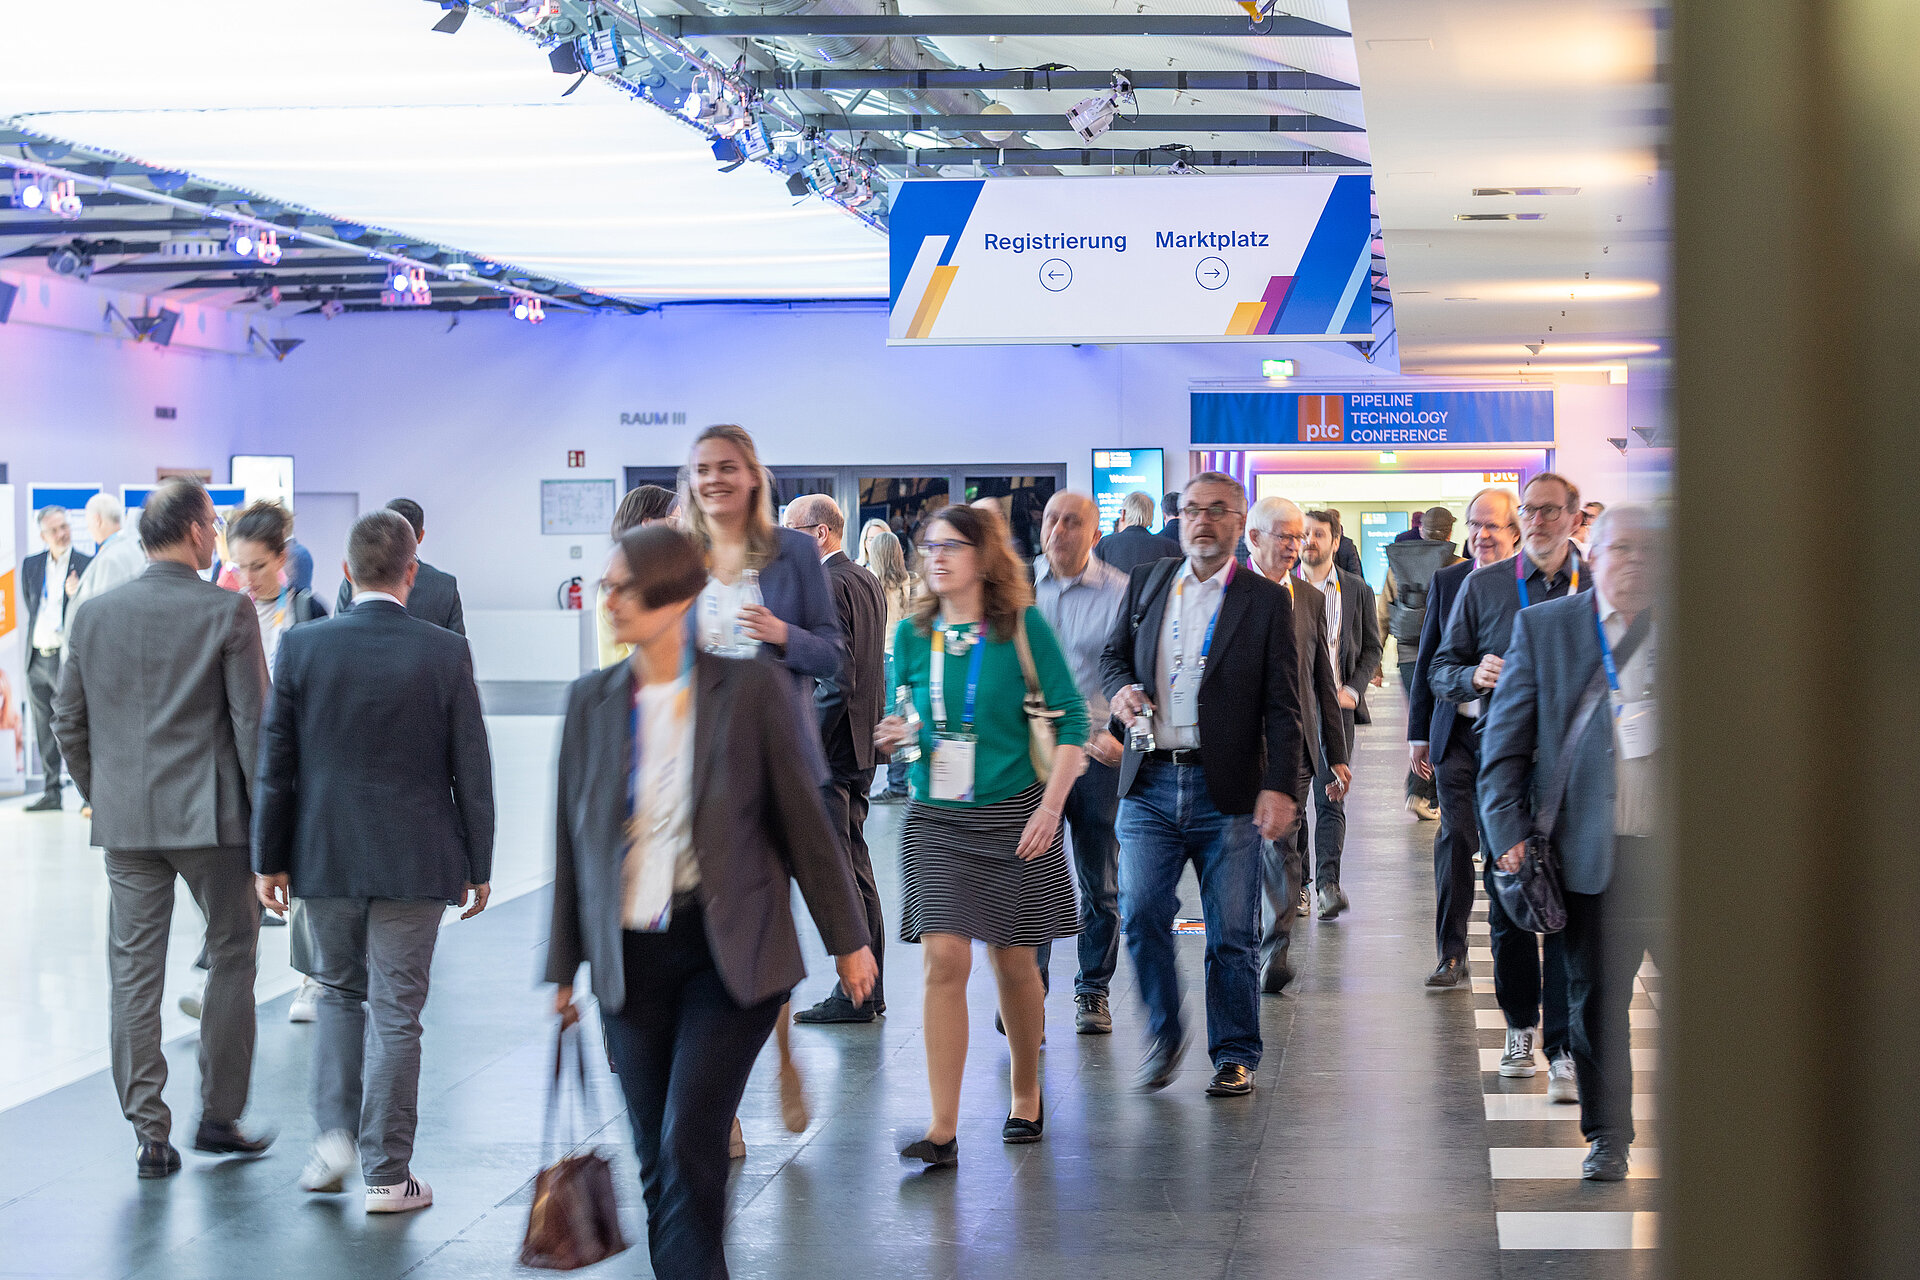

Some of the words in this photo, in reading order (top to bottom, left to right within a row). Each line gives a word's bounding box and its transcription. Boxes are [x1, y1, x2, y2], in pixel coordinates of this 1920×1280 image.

[984, 232, 1128, 254] Registrierung
[1155, 230, 1270, 252] Marktplatz
[1351, 394, 1414, 407] PIPELINE
[620, 412, 669, 425] RAUM
[1350, 411, 1449, 425] TECHNOLOGY
[1306, 423, 1341, 442] ptc
[1350, 428, 1448, 442] CONFERENCE
